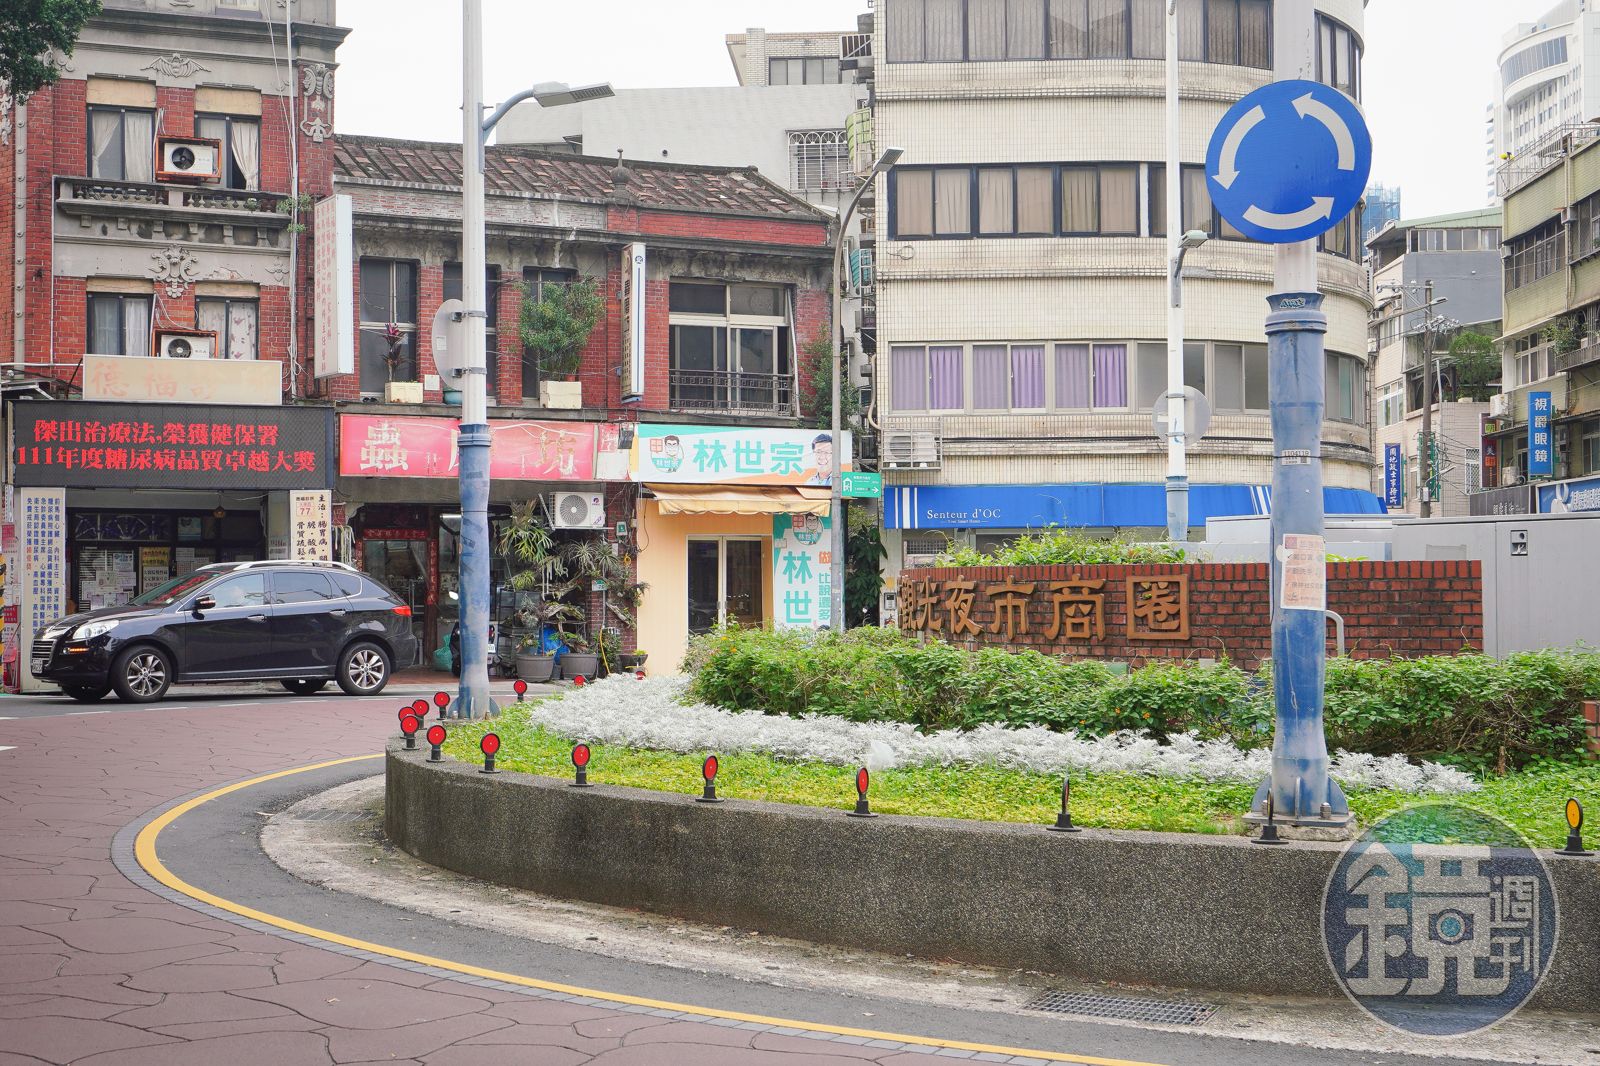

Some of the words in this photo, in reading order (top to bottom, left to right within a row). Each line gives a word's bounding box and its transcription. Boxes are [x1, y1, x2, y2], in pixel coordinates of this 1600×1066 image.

[1535, 398, 1548, 462] 視爵眼鏡
[17, 446, 316, 473] 111年度糖尿病品質卓越大獎
[693, 439, 805, 475] 林世宗
[927, 509, 968, 519] Senteur
[783, 551, 813, 623] 林世
[897, 574, 1191, 640] 觀光夜市商圈
